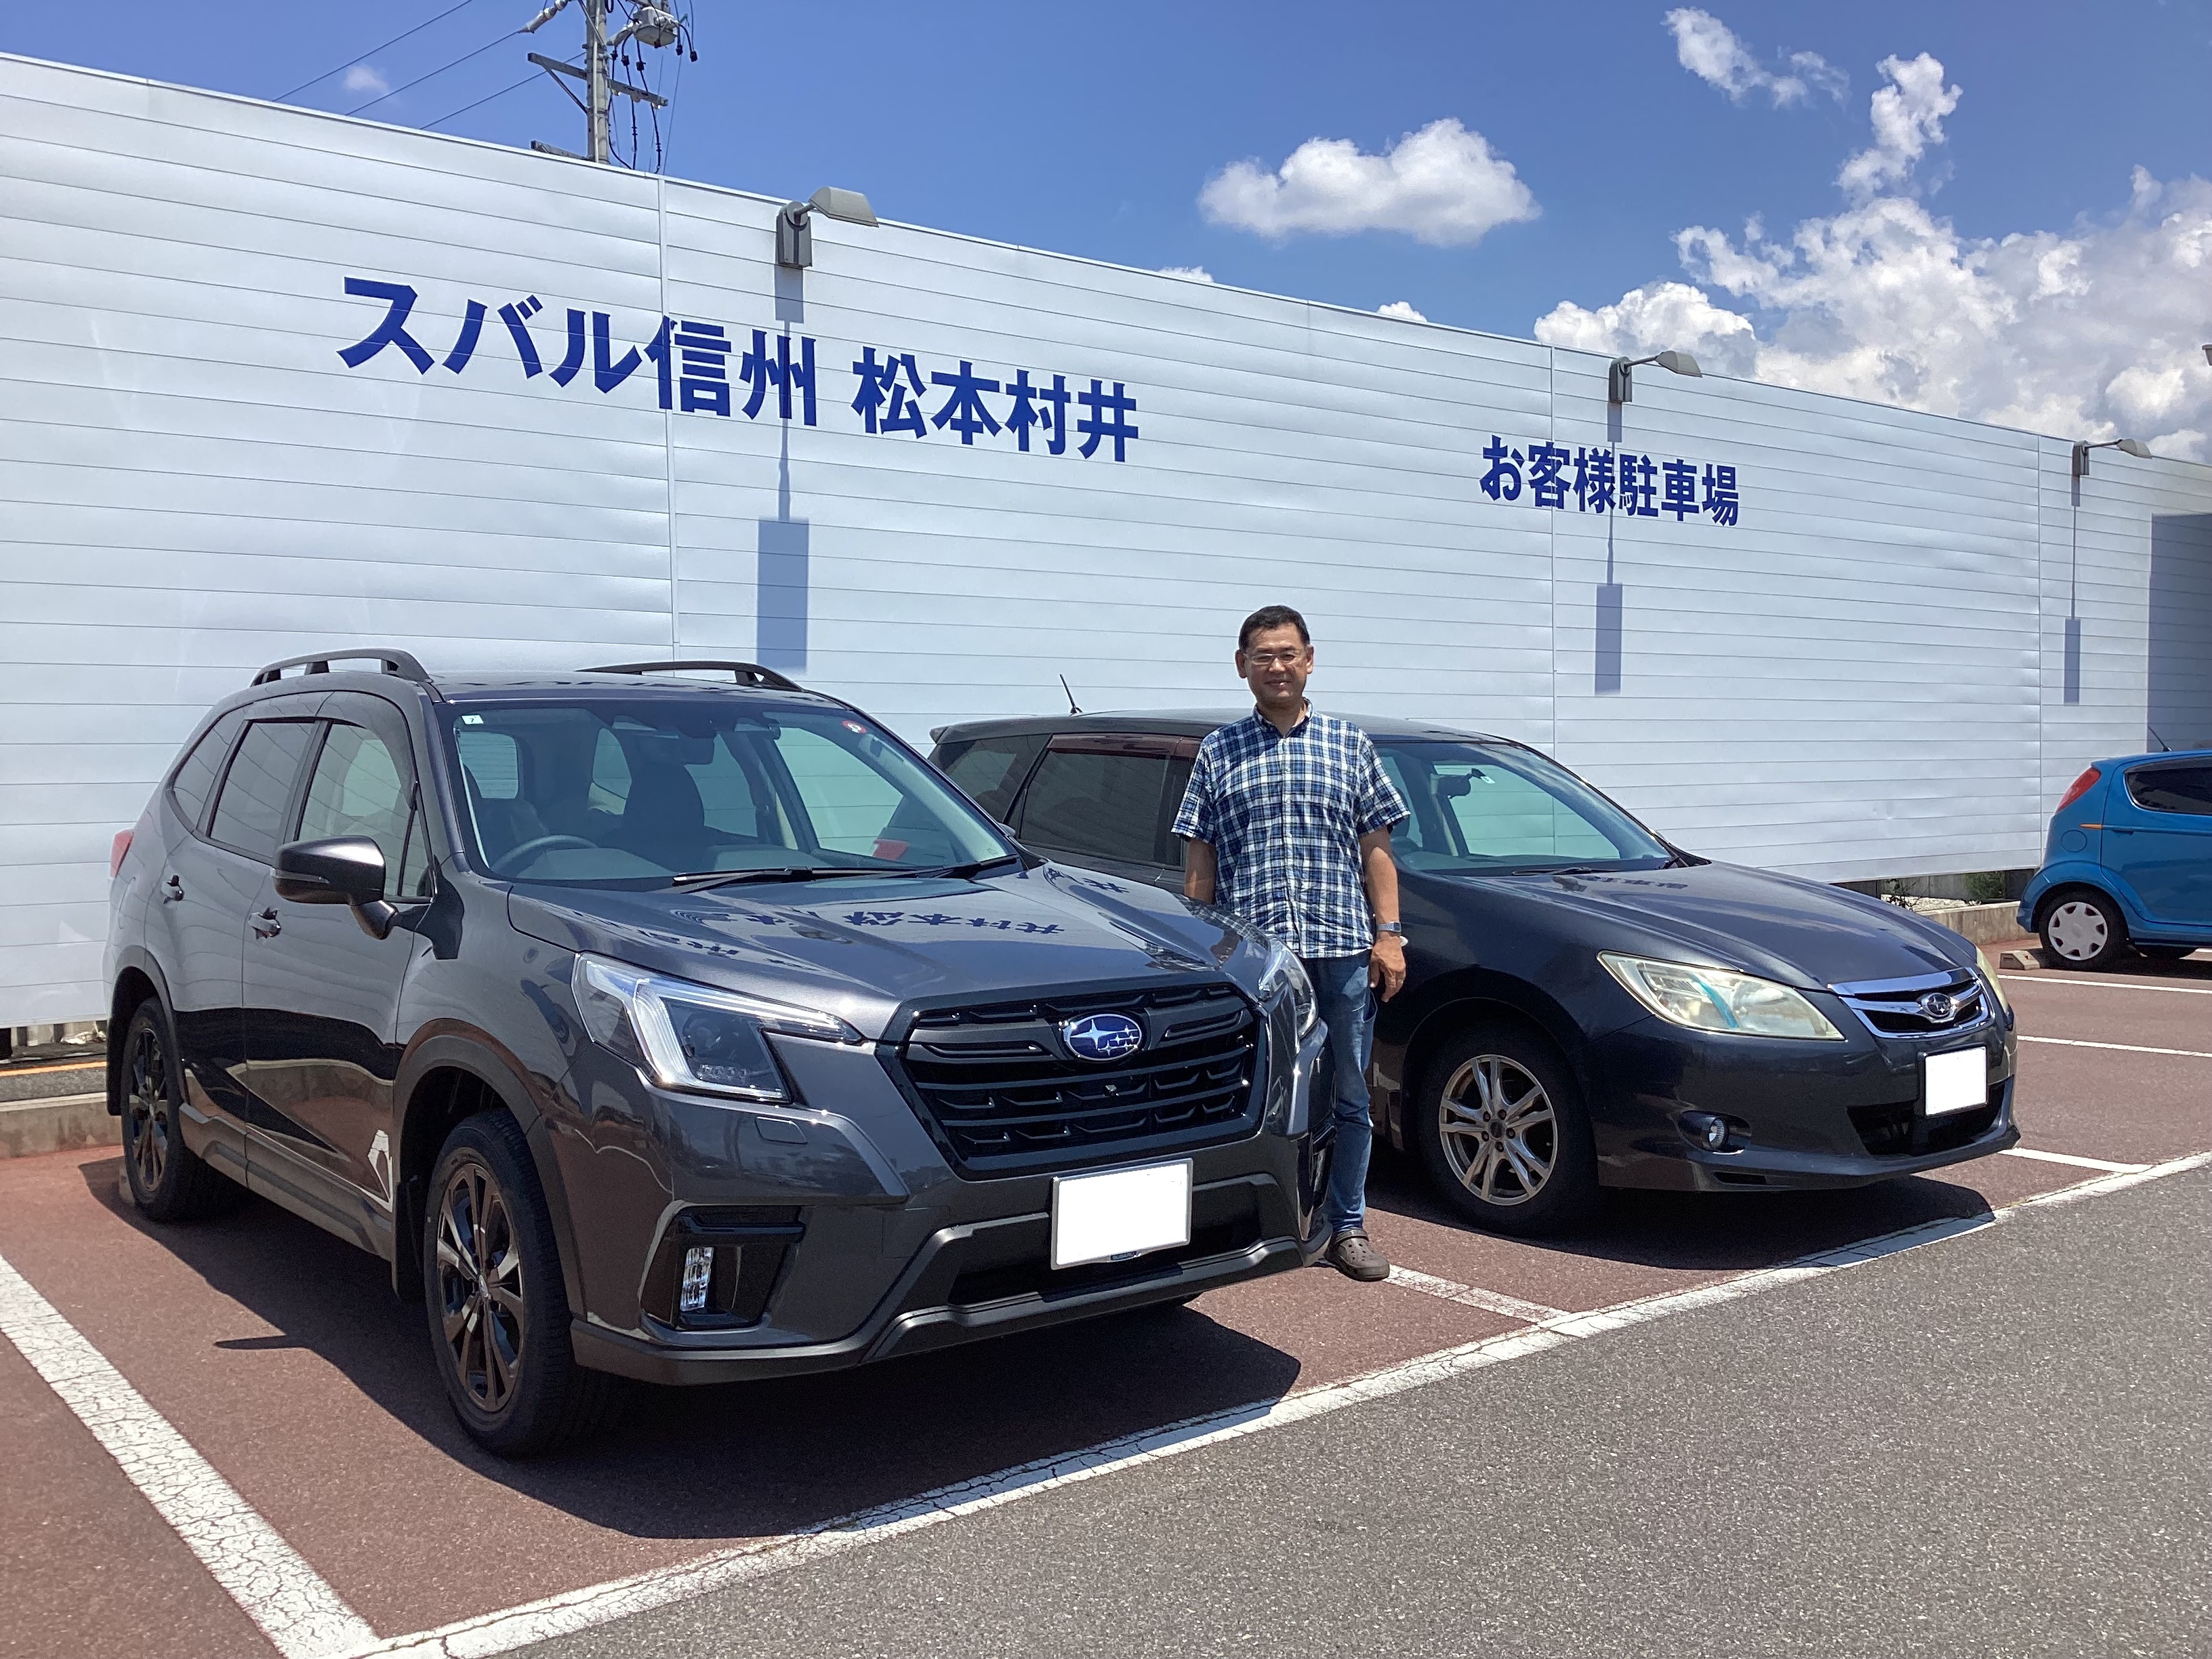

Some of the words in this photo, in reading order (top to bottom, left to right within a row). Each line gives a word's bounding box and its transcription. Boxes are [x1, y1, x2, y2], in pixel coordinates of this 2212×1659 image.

[337, 276, 817, 427] スバル信州
[851, 346, 1140, 463] 松本村井
[1479, 434, 1739, 527] お客様駐車場
